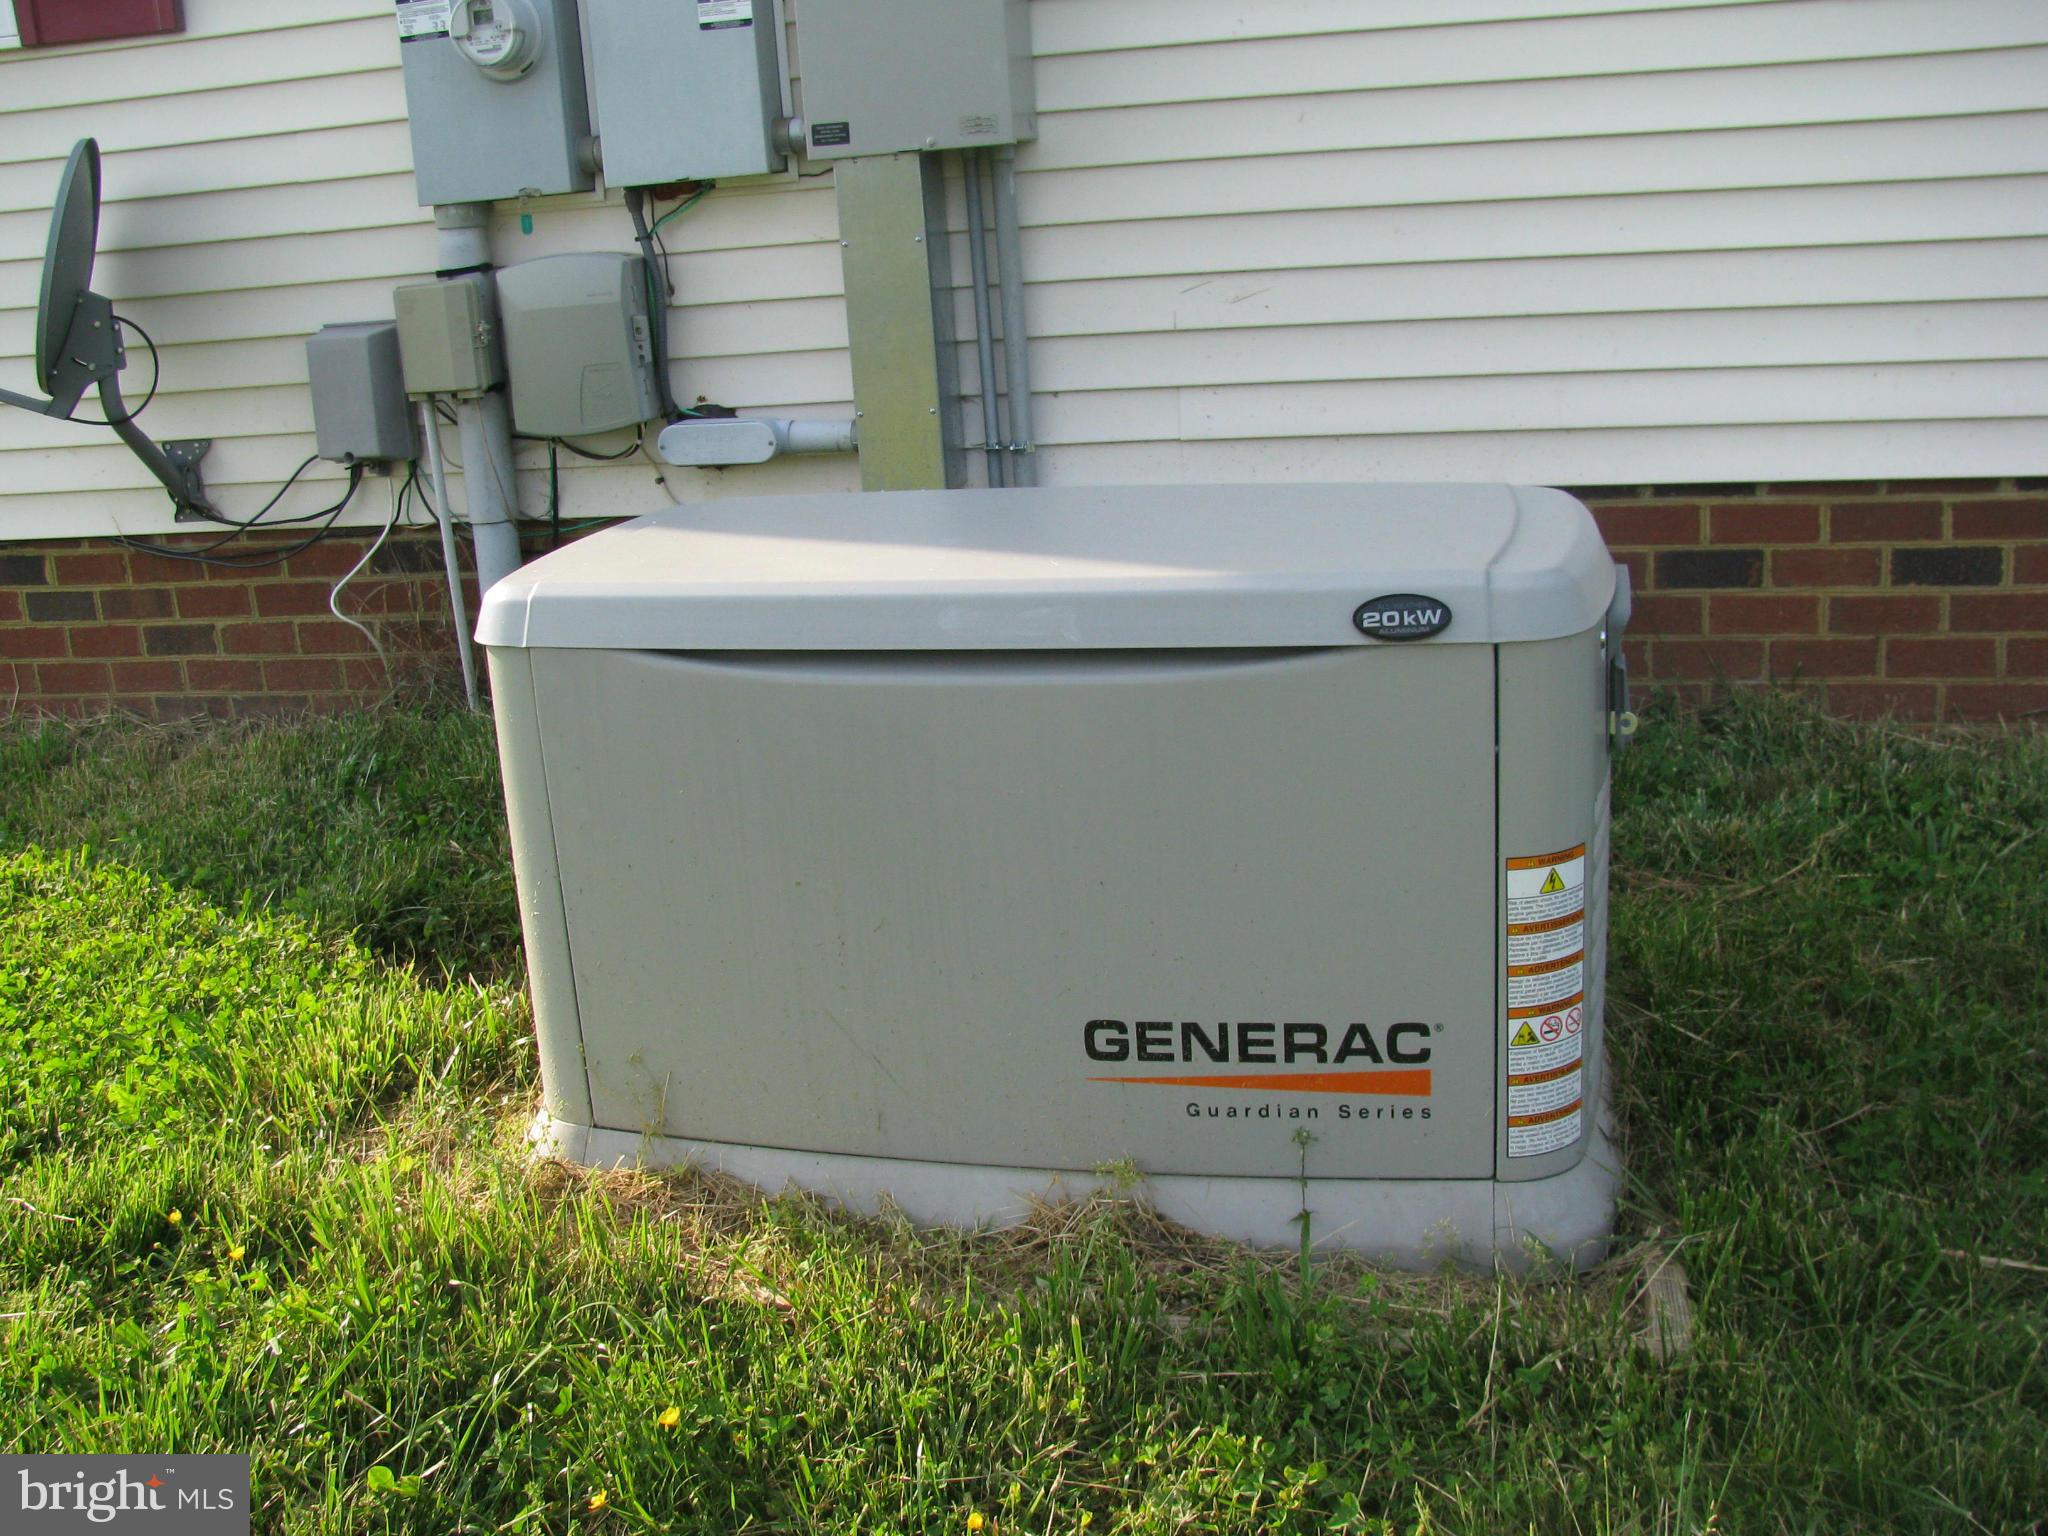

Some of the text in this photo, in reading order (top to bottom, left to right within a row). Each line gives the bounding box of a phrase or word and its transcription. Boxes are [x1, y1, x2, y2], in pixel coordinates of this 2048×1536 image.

[1185, 1102, 1433, 1120] Guardian Series
[1528, 1105, 1579, 1123] ADVERT
